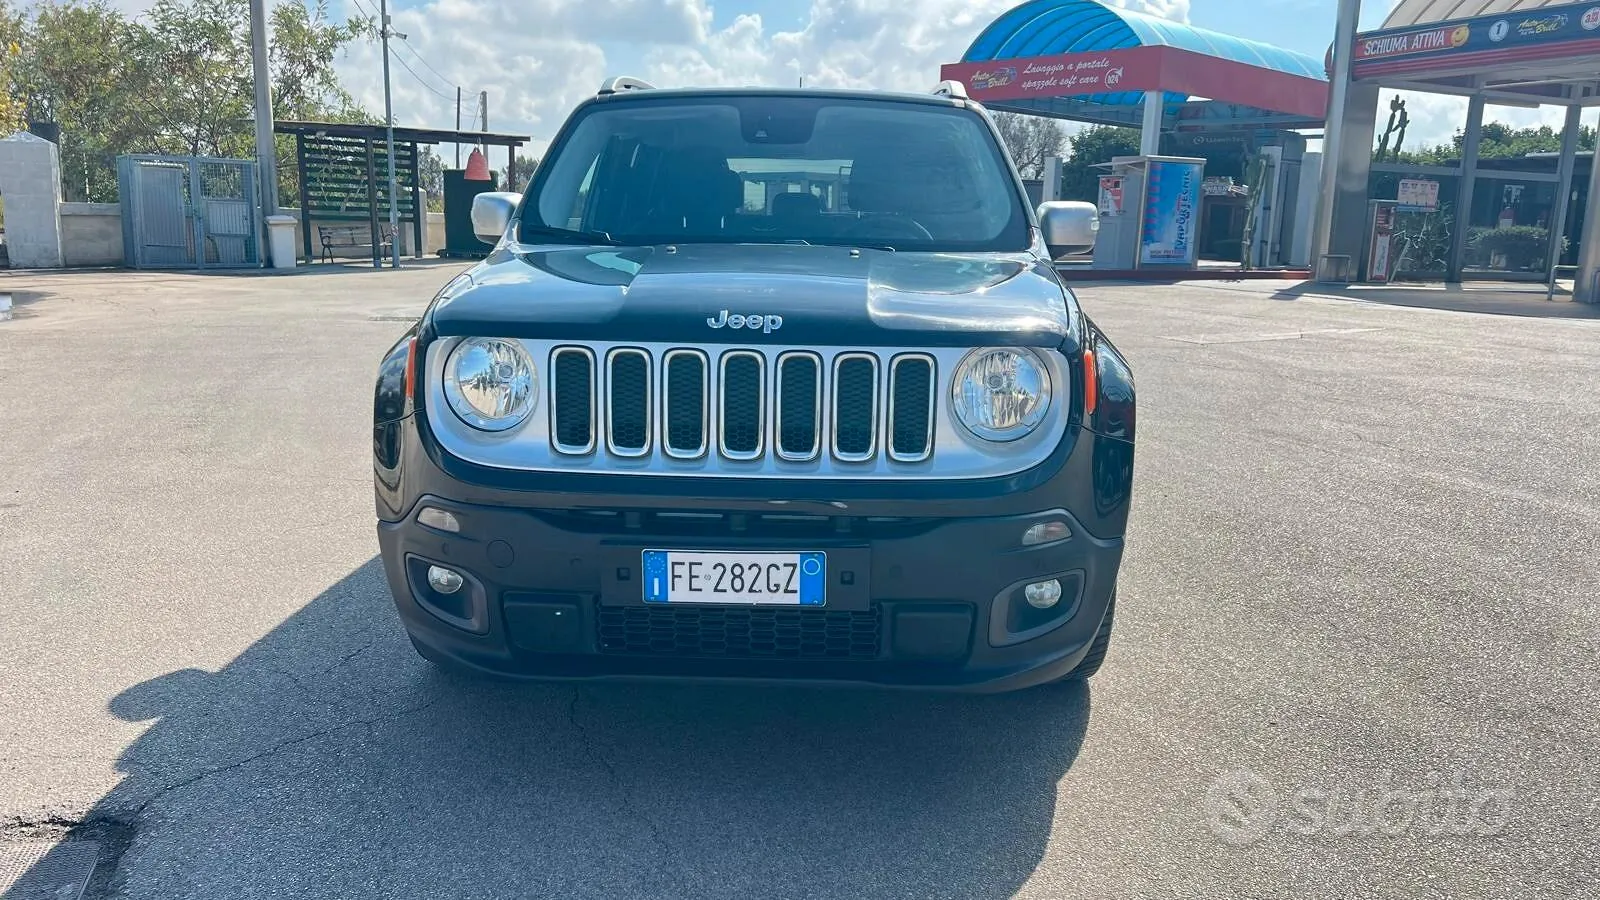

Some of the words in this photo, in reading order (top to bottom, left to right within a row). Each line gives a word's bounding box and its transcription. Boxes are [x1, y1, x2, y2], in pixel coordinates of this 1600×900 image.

[1363, 36, 1408, 55] SCHIUMA
[1411, 31, 1445, 49] ATTIVA
[970, 70, 991, 81] Auto
[1022, 63, 1065, 76] Lavaggio
[1076, 58, 1110, 72] portale
[1021, 78, 1057, 92] spazzole
[1059, 76, 1078, 89] soft
[1079, 76, 1099, 85] care
[706, 309, 783, 334] Jeep
[671, 561, 703, 592] FE
[712, 562, 798, 594] 282GZ
